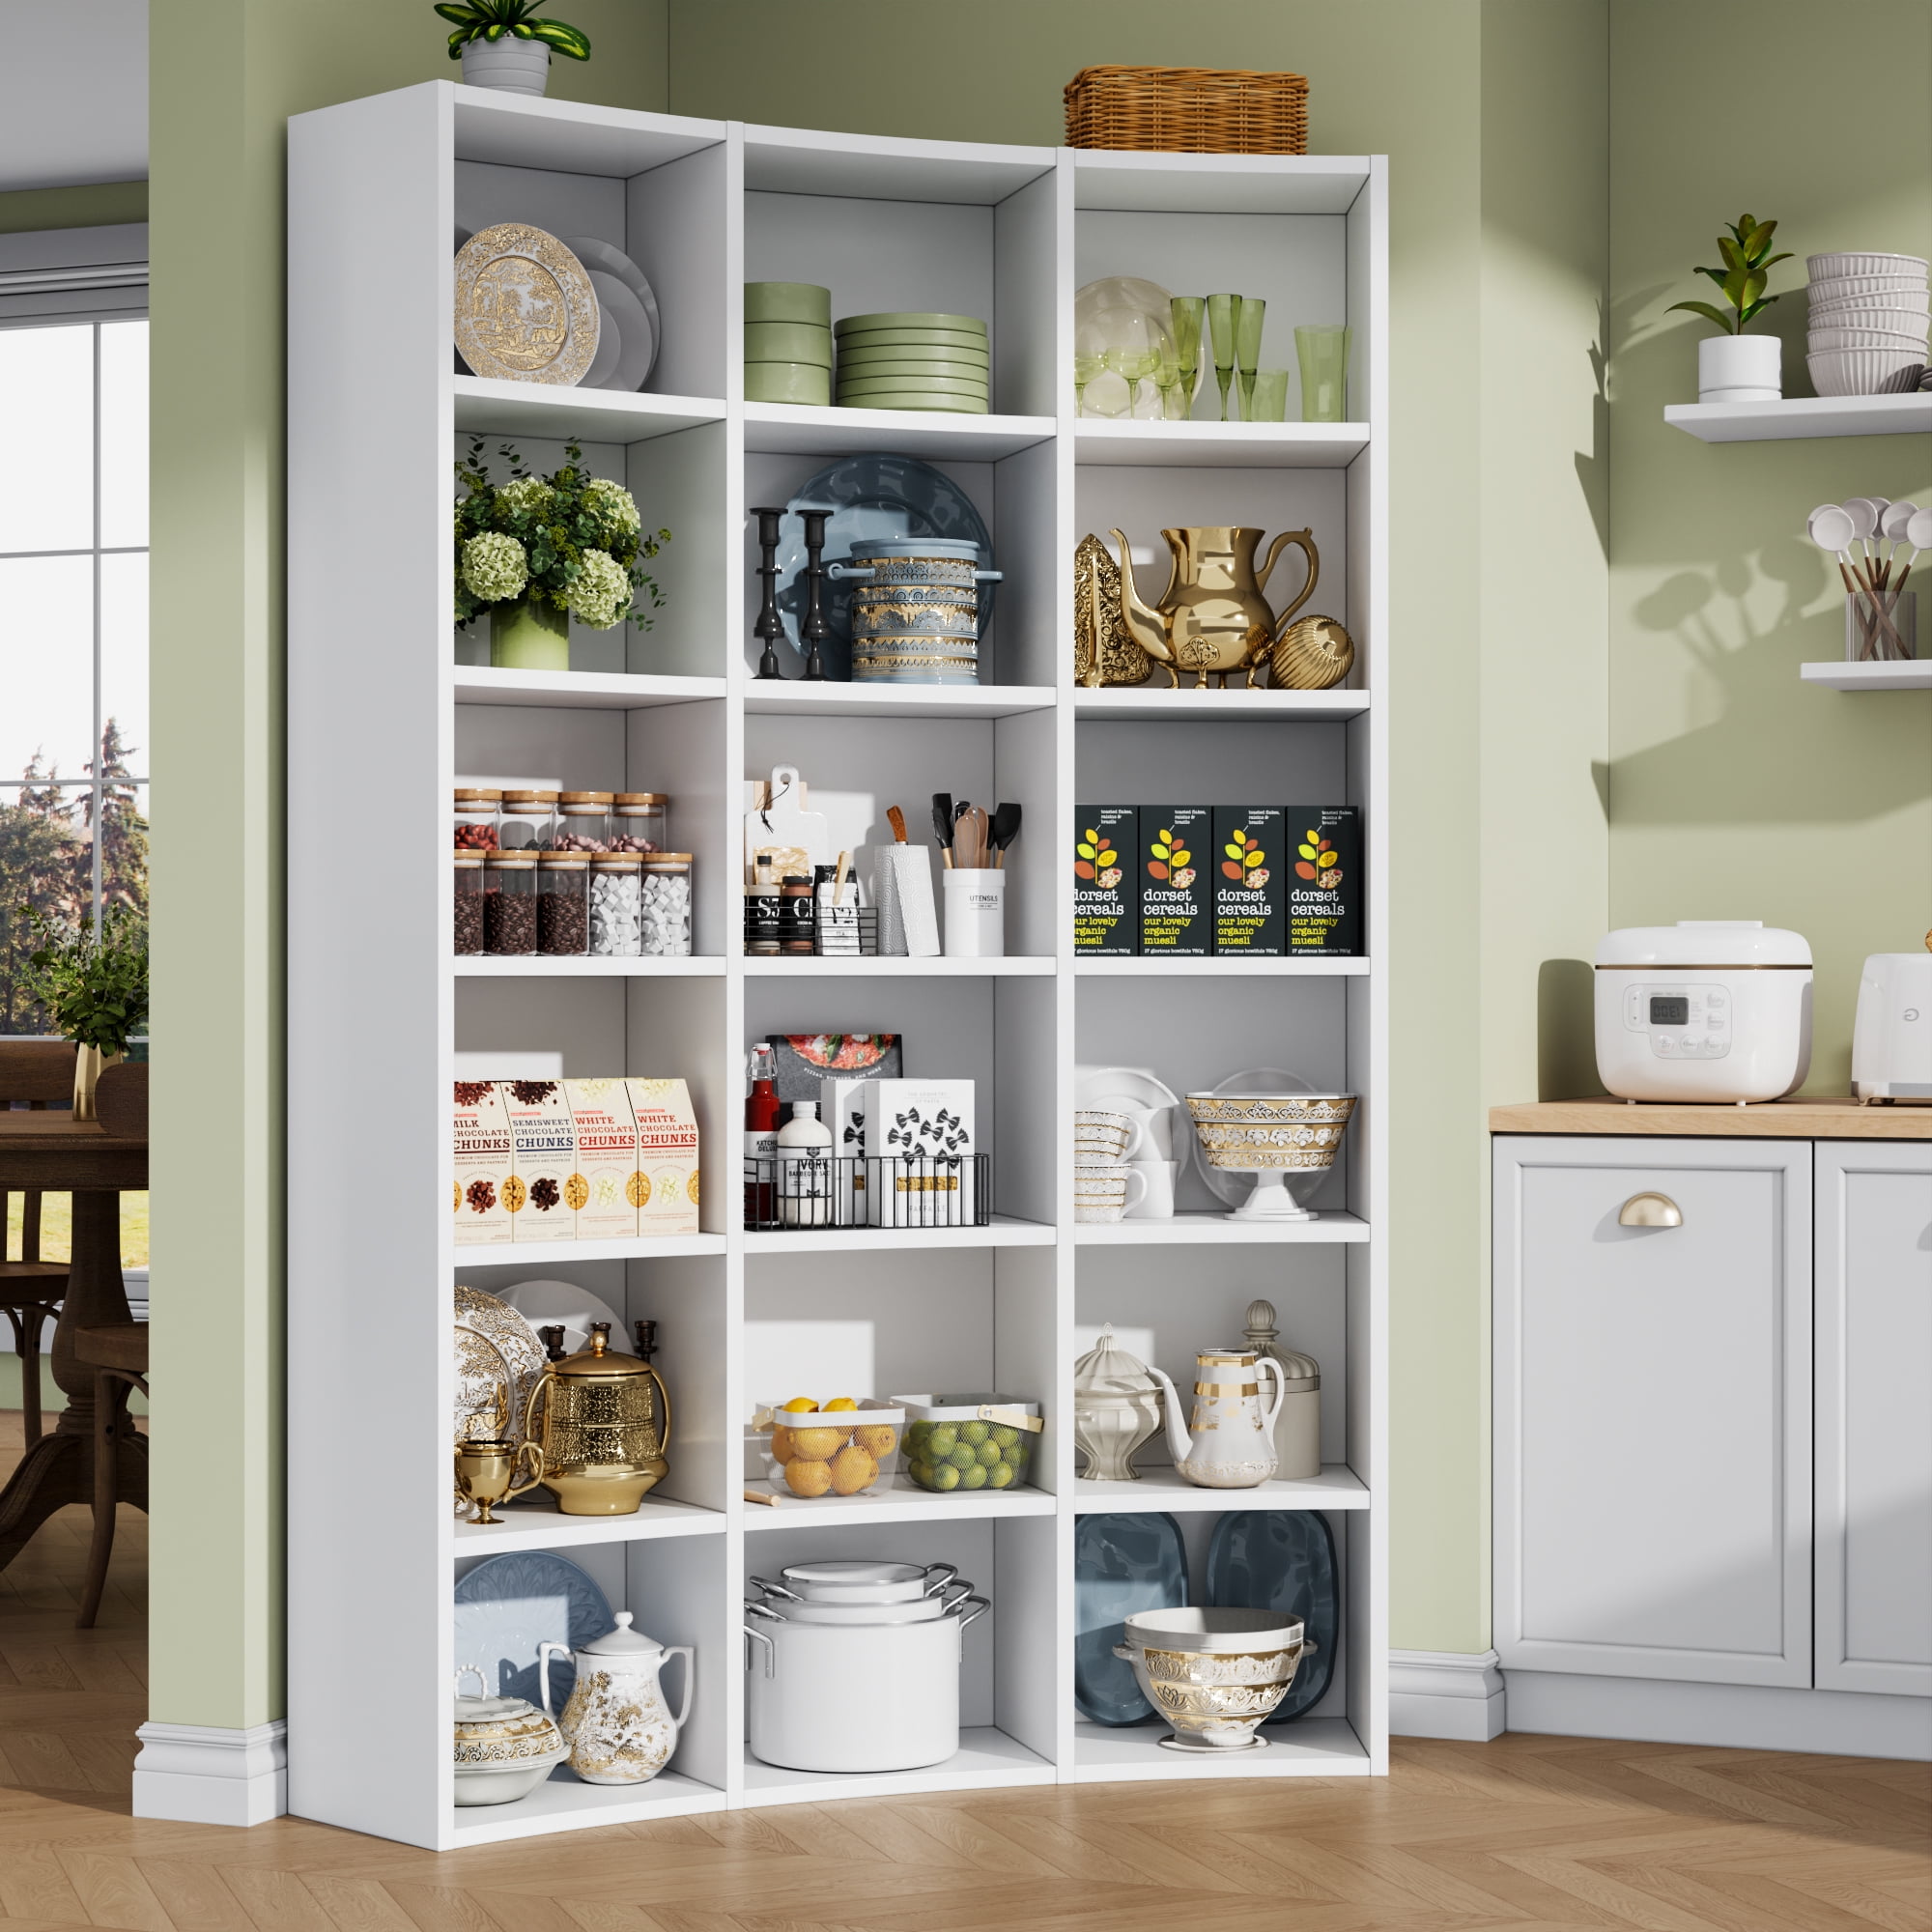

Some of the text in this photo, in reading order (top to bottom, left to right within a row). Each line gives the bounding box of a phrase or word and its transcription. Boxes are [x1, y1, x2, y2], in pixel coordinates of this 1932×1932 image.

[1144, 889, 1192, 901] dorset
[1218, 889, 1266, 901] dorset
[1291, 889, 1339, 901] dorset
[1144, 903, 1198, 915] cereals
[1218, 903, 1272, 915] cereals
[1291, 903, 1345, 915] cereals
[1089, 917, 1118, 927] lovely
[1163, 917, 1191, 927] lovely
[1237, 917, 1265, 927] lovely
[1310, 917, 1338, 927] lovely
[1144, 927, 1180, 936] organic
[1218, 927, 1254, 936] organic
[1291, 927, 1327, 936] organic
[1144, 936, 1177, 944] muesli
[1218, 936, 1250, 945] muesli
[1291, 936, 1324, 945] muesli
[454, 1139, 510, 1149] CHUNKS
[516, 1137, 573, 1148] CHUNKS
[579, 1135, 635, 1146] CHUNKS
[641, 1134, 696, 1144] CHUNKS
